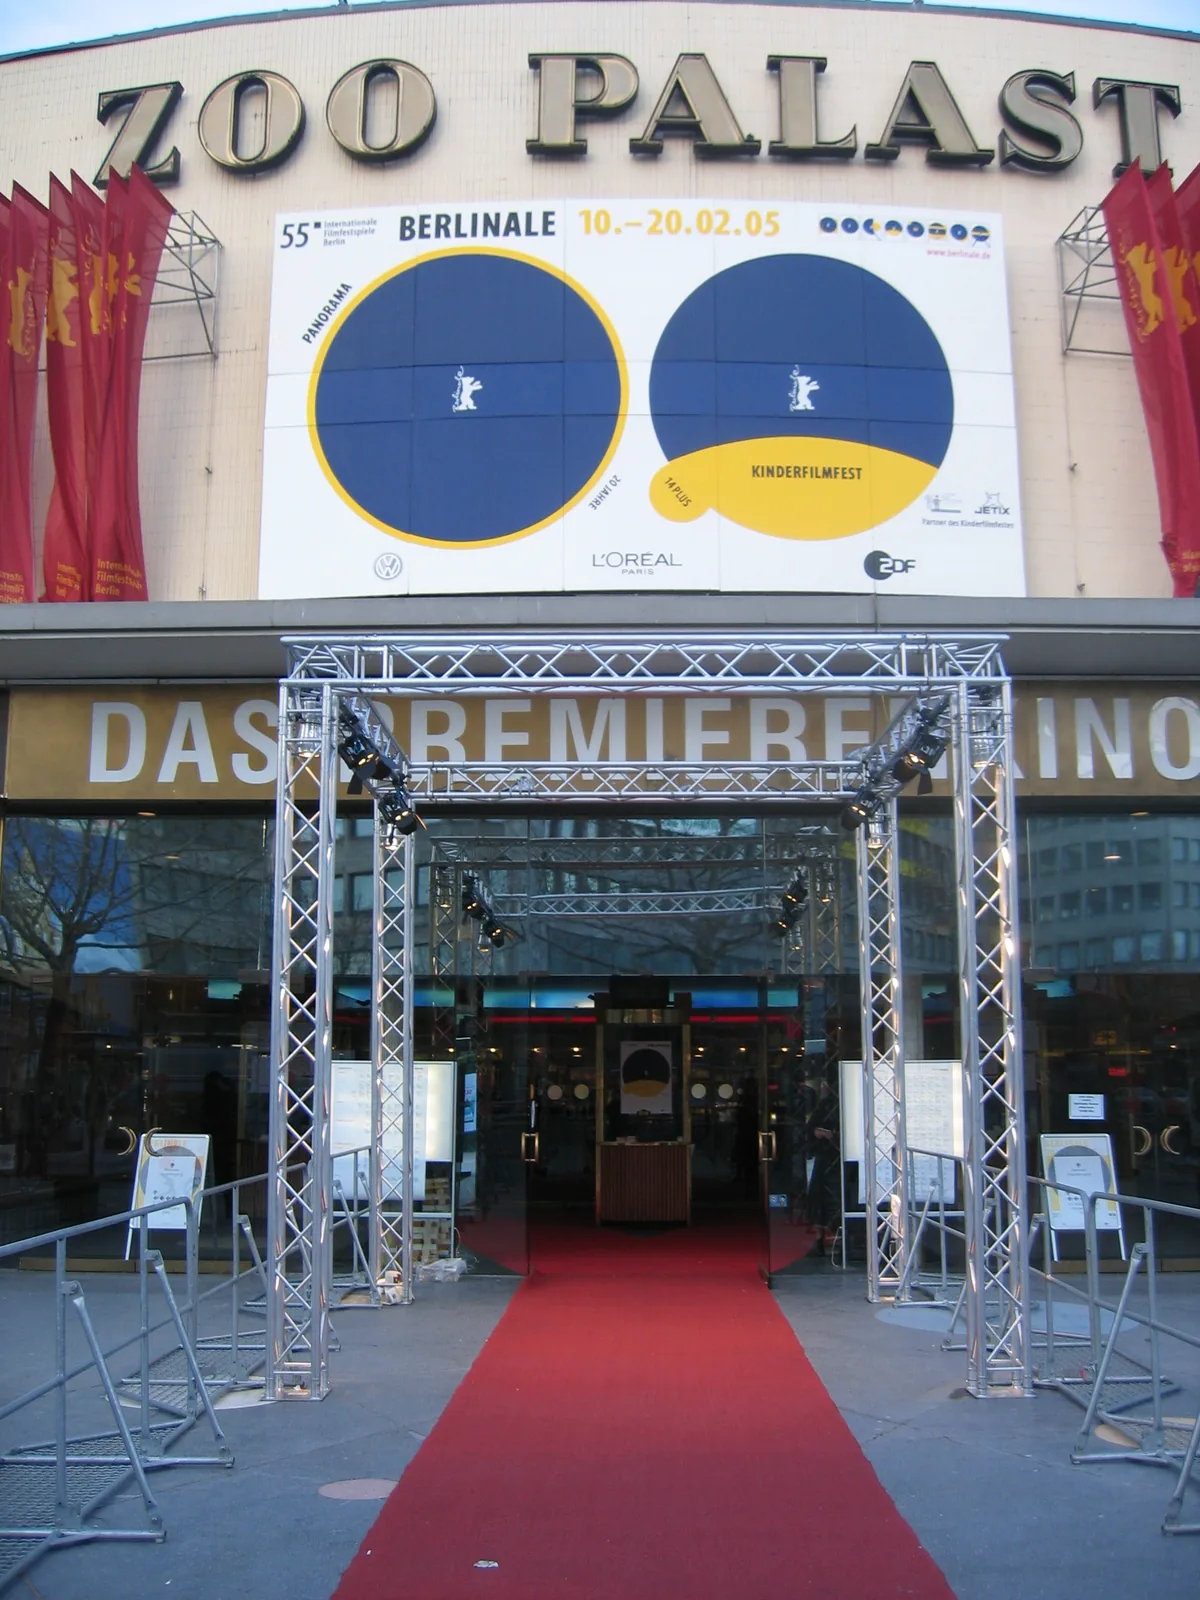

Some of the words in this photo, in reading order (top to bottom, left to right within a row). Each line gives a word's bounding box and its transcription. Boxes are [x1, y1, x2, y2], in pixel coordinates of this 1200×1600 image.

[94, 58, 438, 190] ZOO
[525, 51, 1182, 180] PALAST
[323, 217, 377, 228] Internationale
[323, 227, 376, 238] Filmfestspiele
[399, 210, 556, 241] BERLINALE
[323, 238, 346, 247] Berlin
[301, 281, 353, 344] PANORAMA
[751, 464, 863, 480] KINDERFILMFEST
[587, 484, 613, 511] JAHRE
[974, 506, 1011, 516] JETIX
[88, 699, 279, 785] DAS
